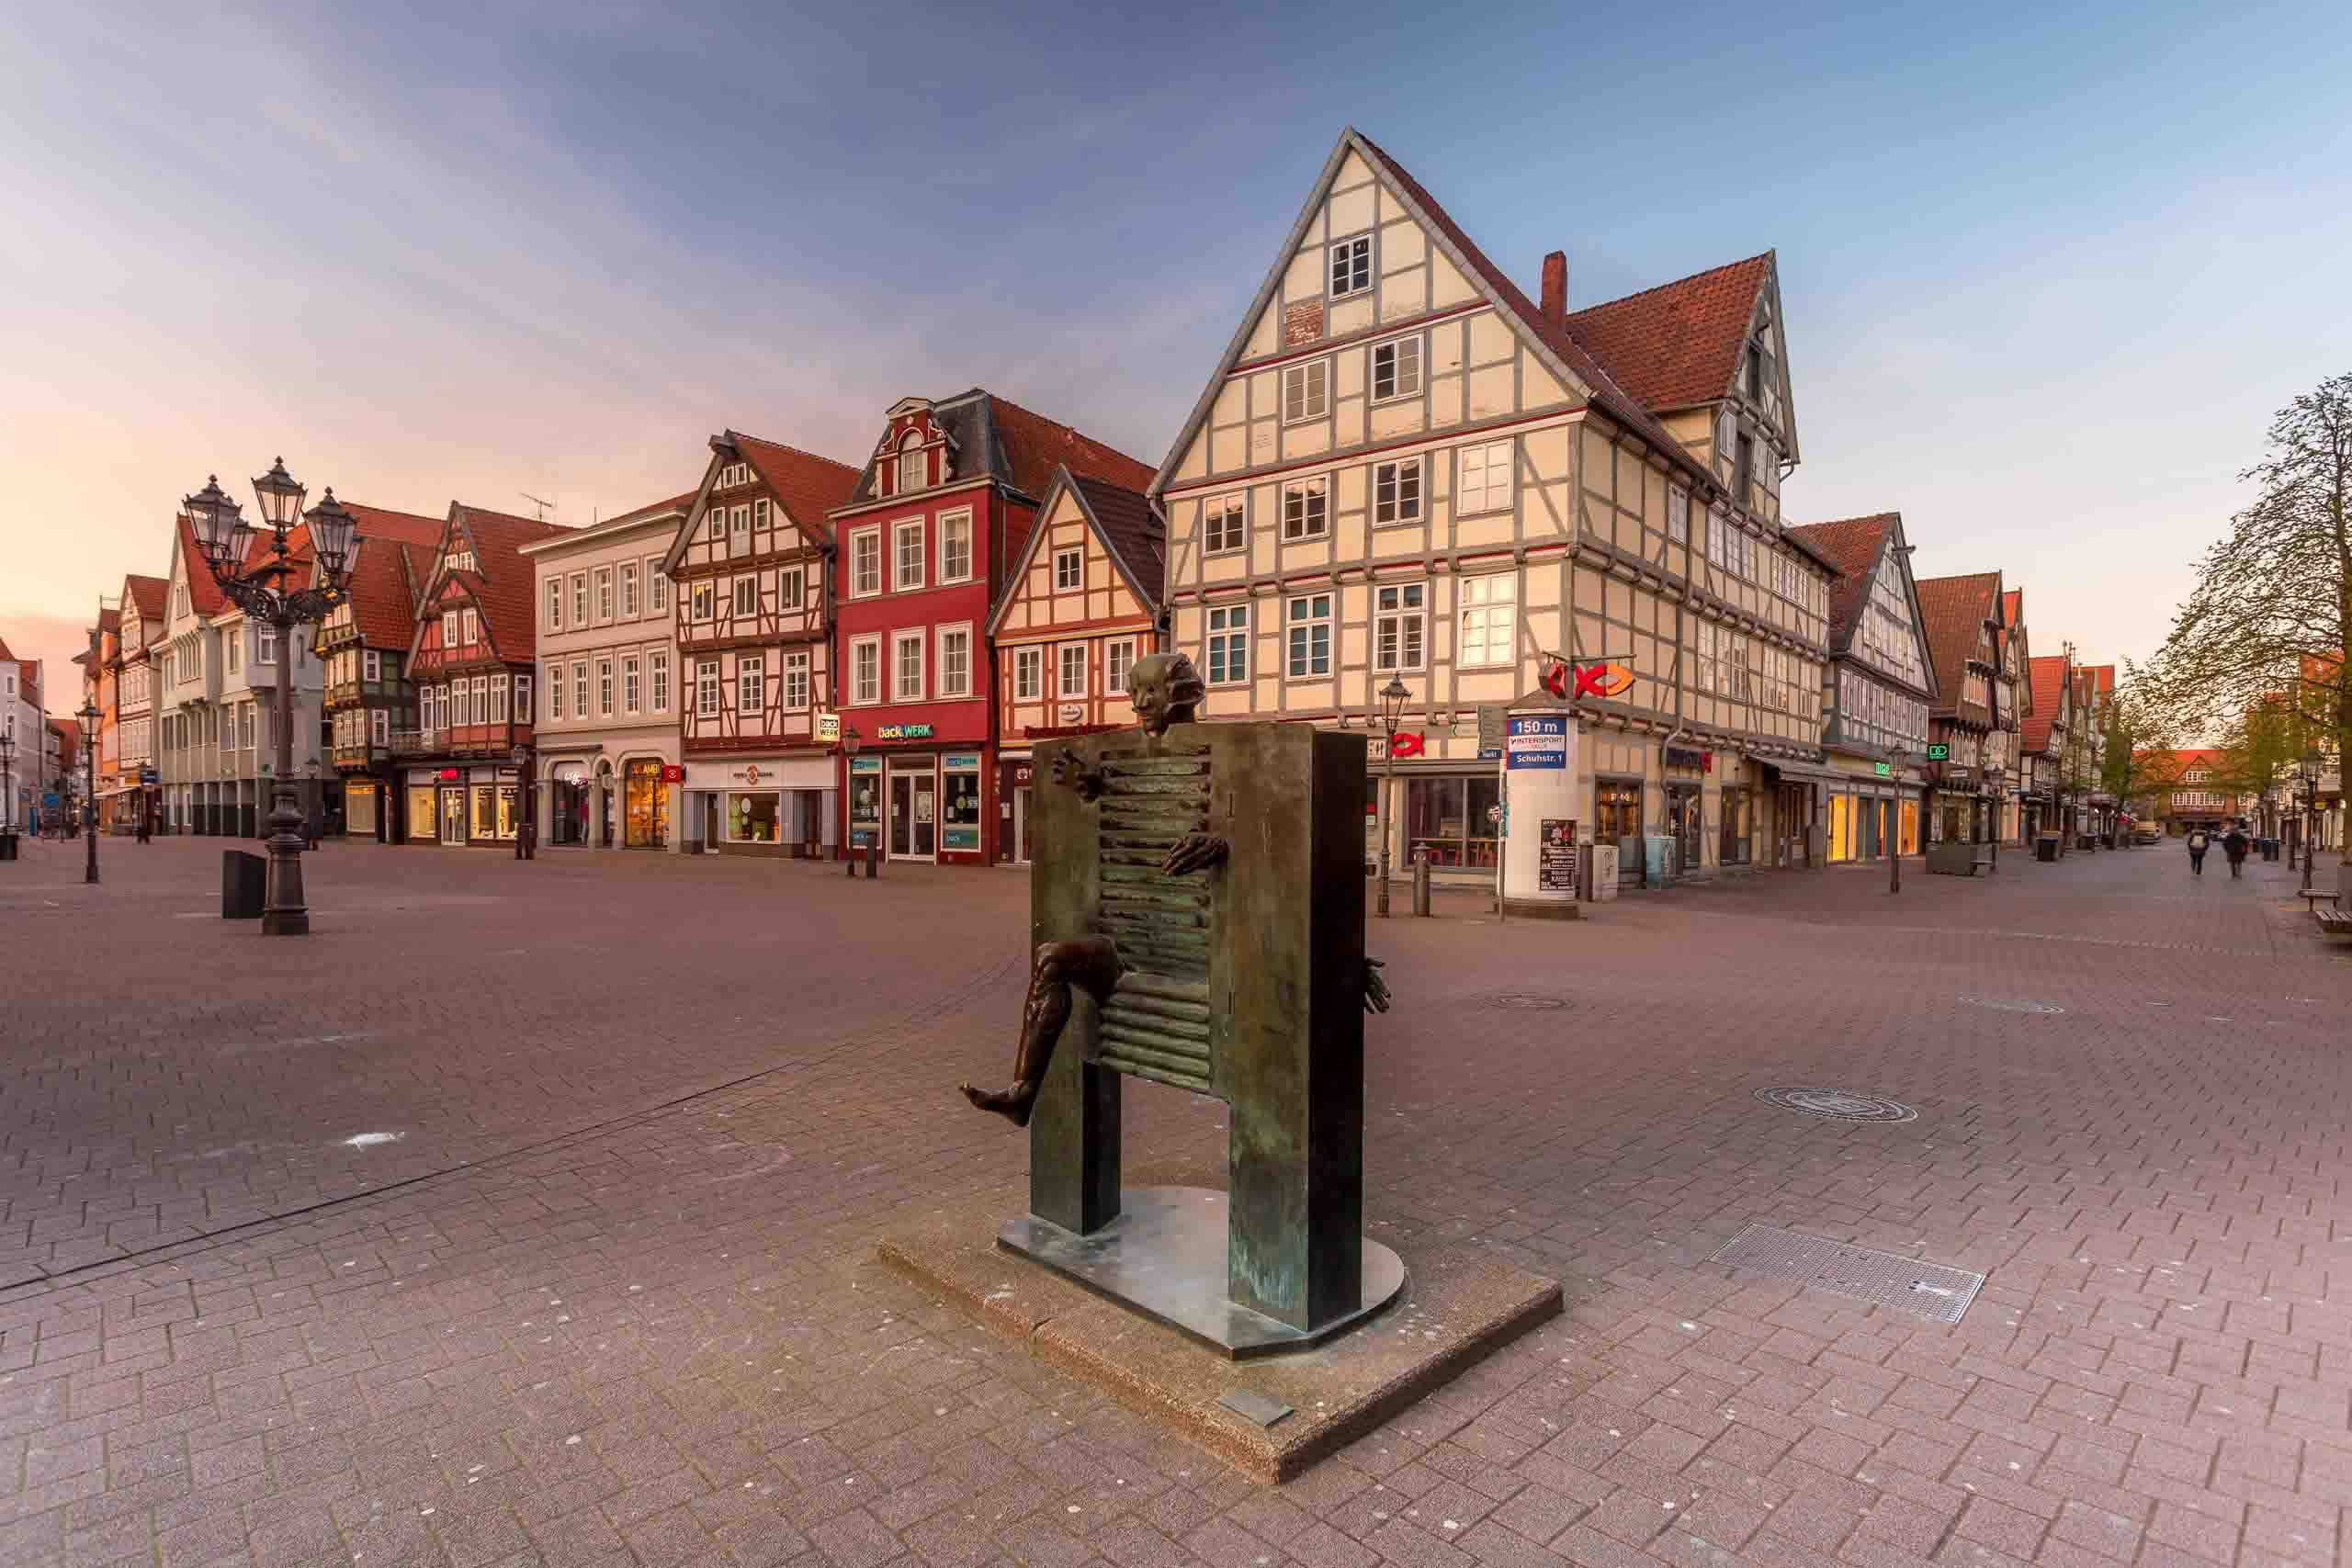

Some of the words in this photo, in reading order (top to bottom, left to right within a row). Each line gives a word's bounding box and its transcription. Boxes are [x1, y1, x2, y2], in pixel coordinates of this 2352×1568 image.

[1517, 721, 1541, 733] 150
[1544, 723, 1558, 733] m
[1517, 754, 1556, 763] Schuhstr.
[1558, 754, 1563, 763] 1
